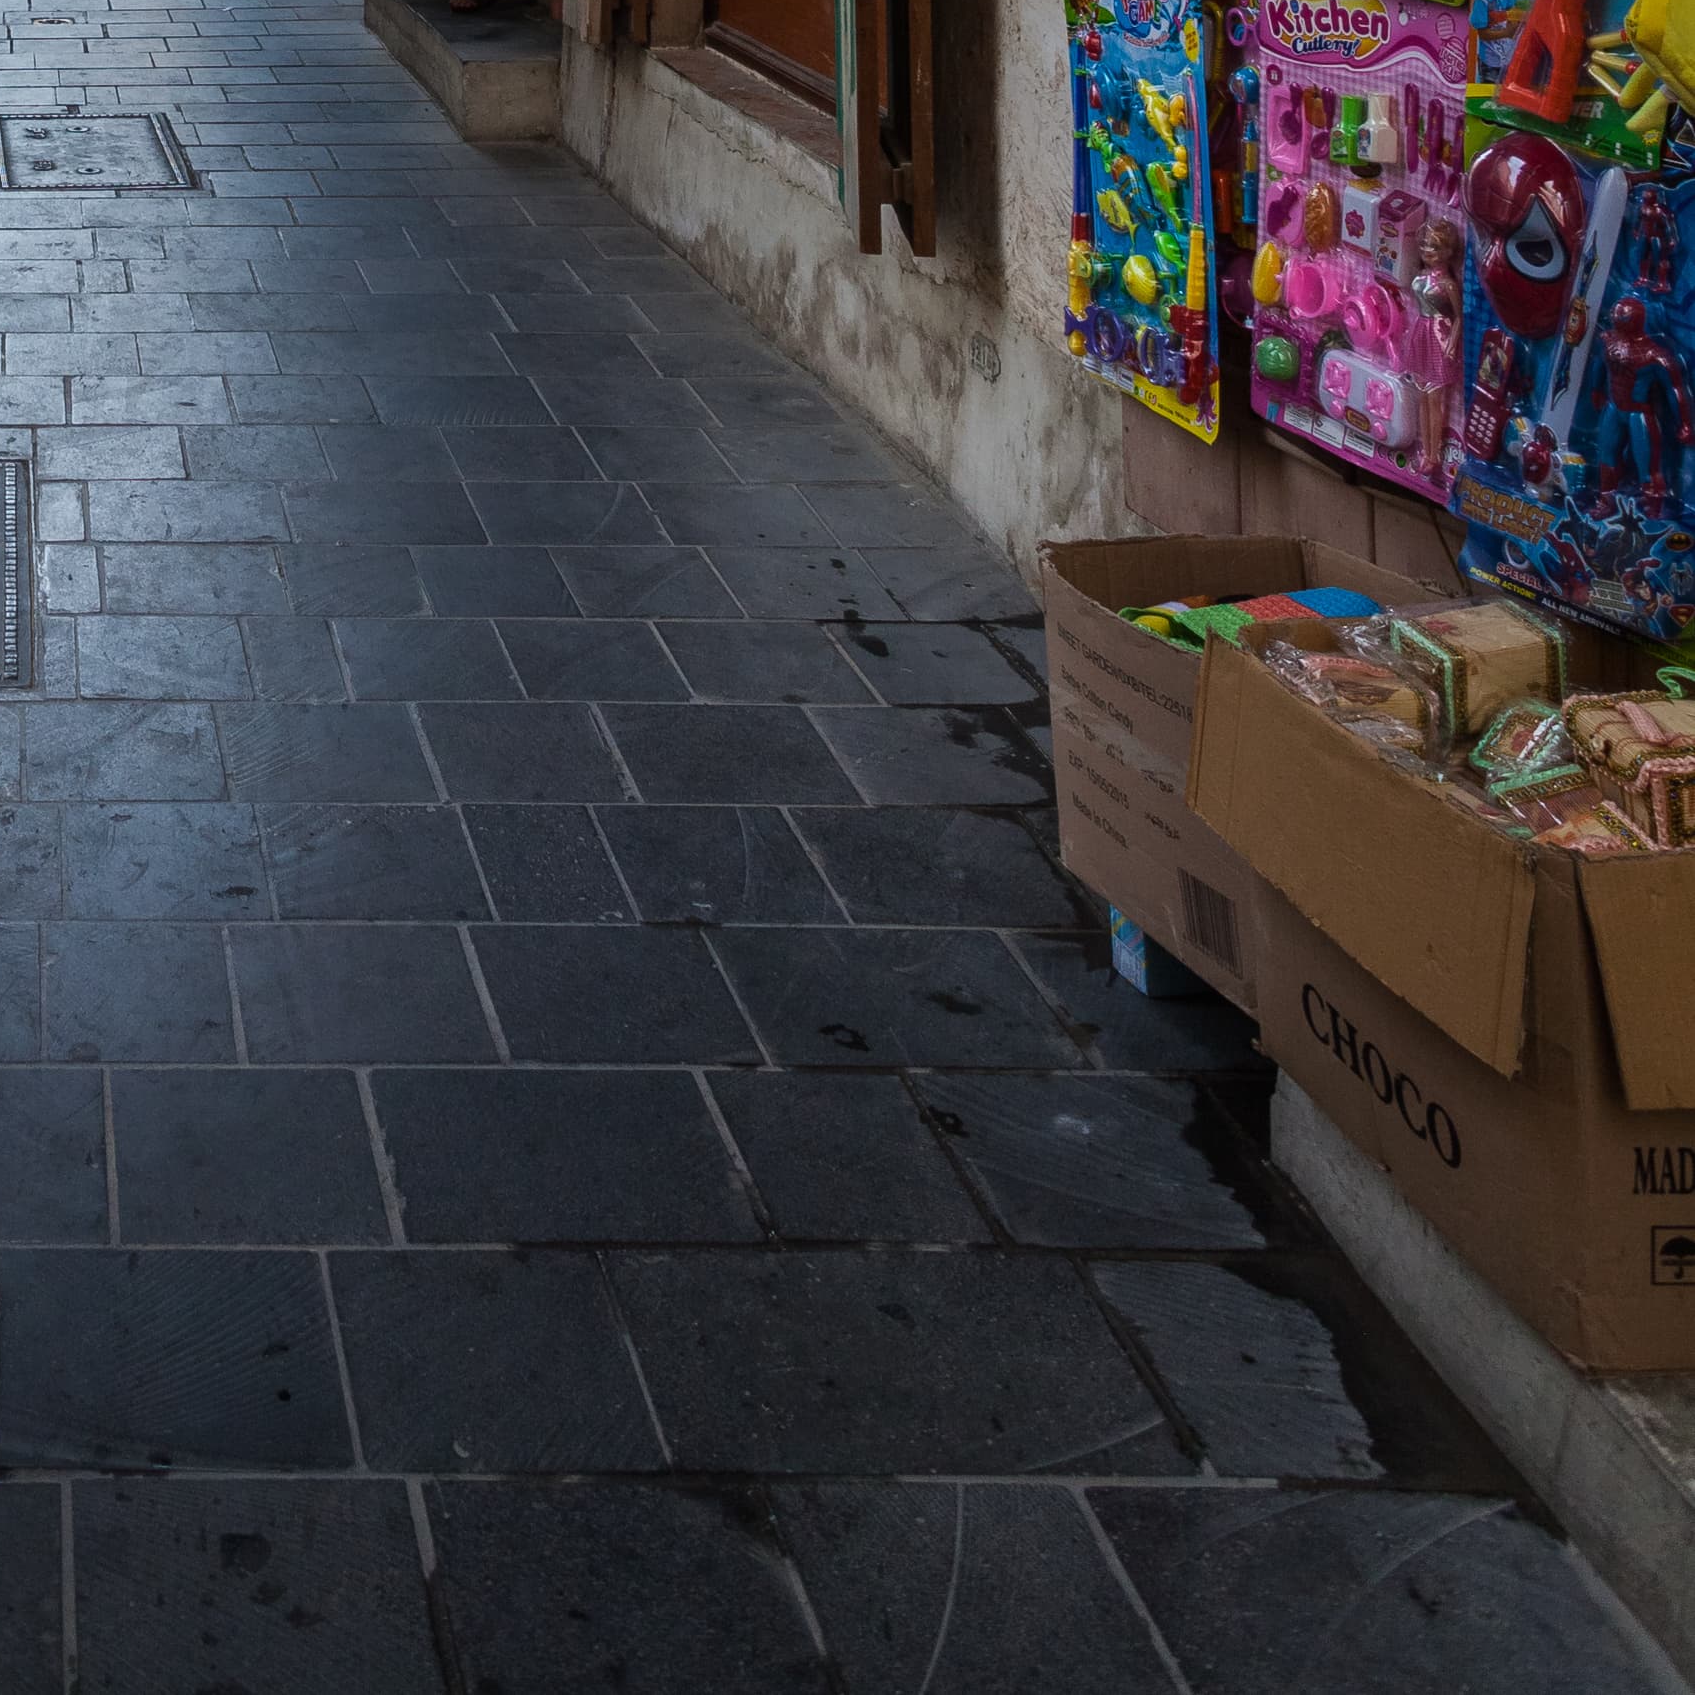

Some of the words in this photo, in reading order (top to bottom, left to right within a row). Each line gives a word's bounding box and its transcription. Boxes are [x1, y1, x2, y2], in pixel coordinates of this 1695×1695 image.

[1292, 35, 1361, 56] Cutlery!
[1469, 567, 1502, 585] POWER
[1541, 596, 1558, 611] ALL
[1559, 604, 1581, 618] NEW
[1302, 983, 1462, 1169] CHOCO
